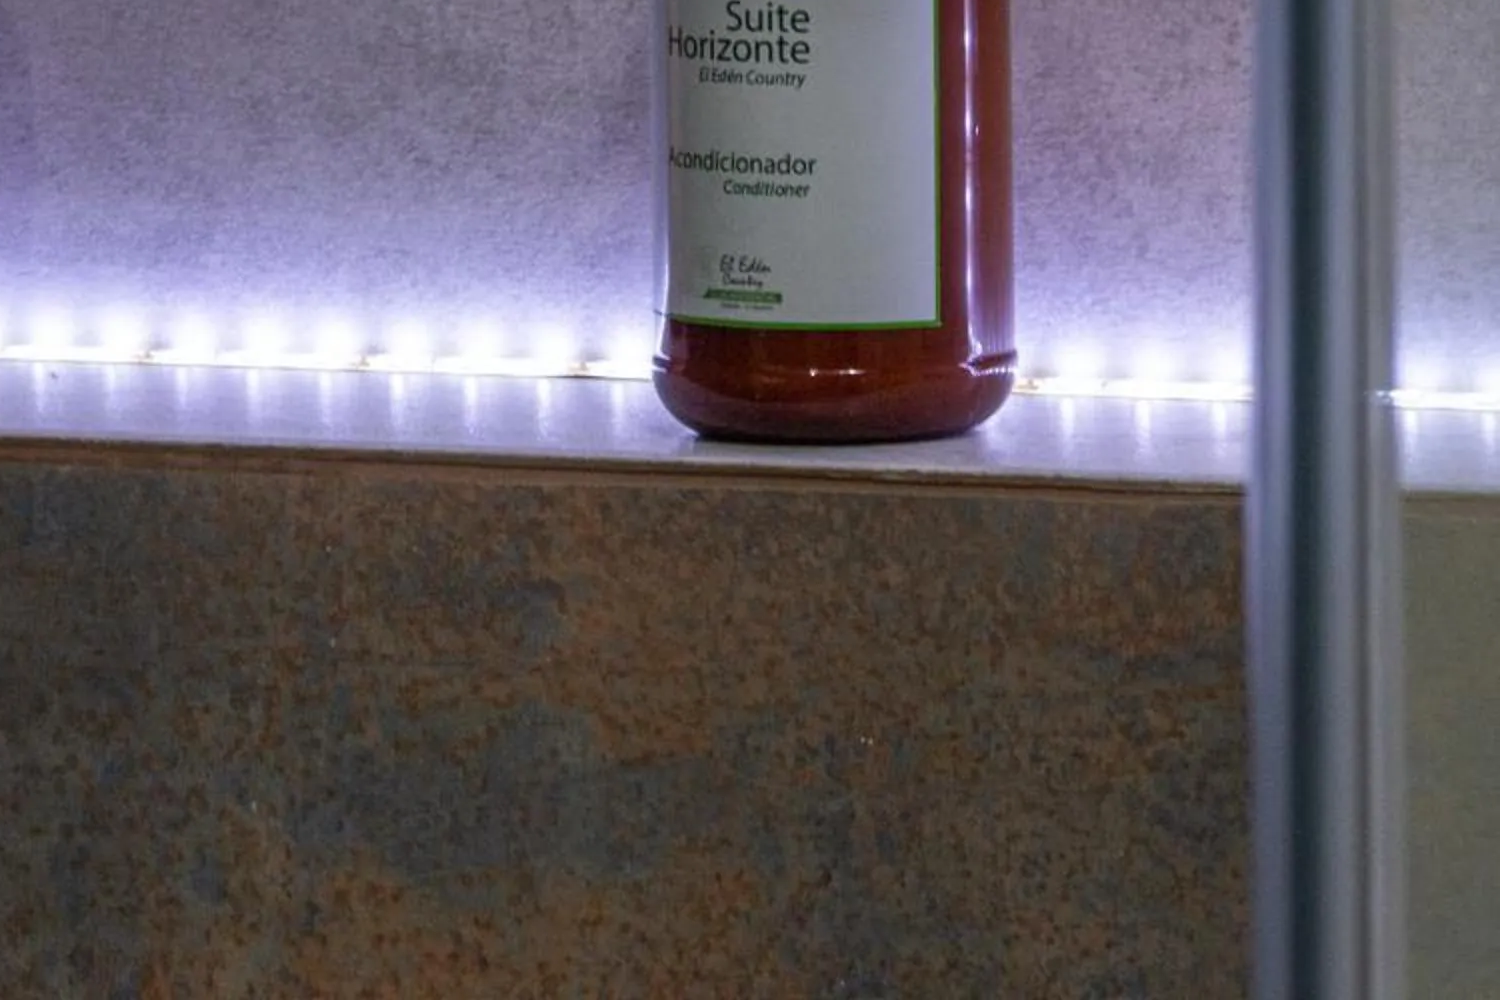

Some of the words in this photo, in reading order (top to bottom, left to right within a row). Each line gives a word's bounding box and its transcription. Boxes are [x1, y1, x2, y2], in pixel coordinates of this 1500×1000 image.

[726, 0, 810, 33] Suite
[668, 26, 810, 64] Horizonte
[746, 69, 805, 89] Country
[723, 179, 810, 198] Conditioner
